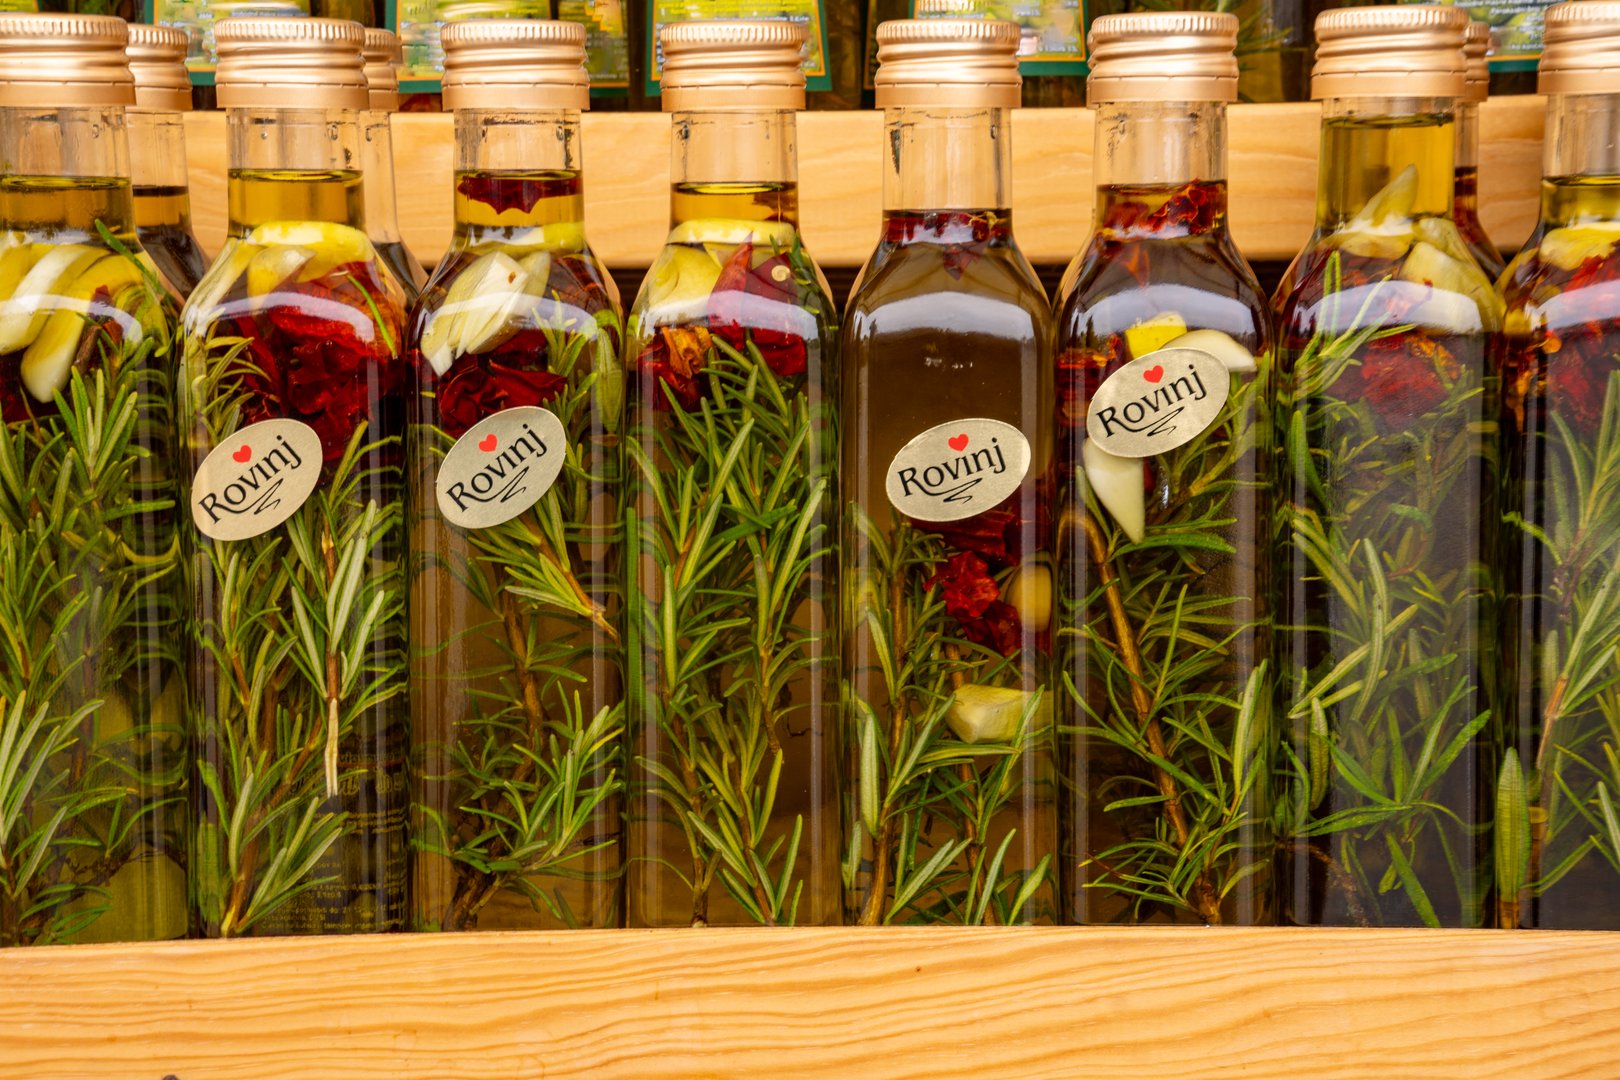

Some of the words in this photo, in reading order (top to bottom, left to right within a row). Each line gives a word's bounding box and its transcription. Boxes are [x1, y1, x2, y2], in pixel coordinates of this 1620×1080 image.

[1096, 363, 1208, 438] Rovinj
[198, 434, 302, 524] Rovinj
[446, 423, 548, 512] Rovinj
[898, 437, 1007, 504] Rovinj
